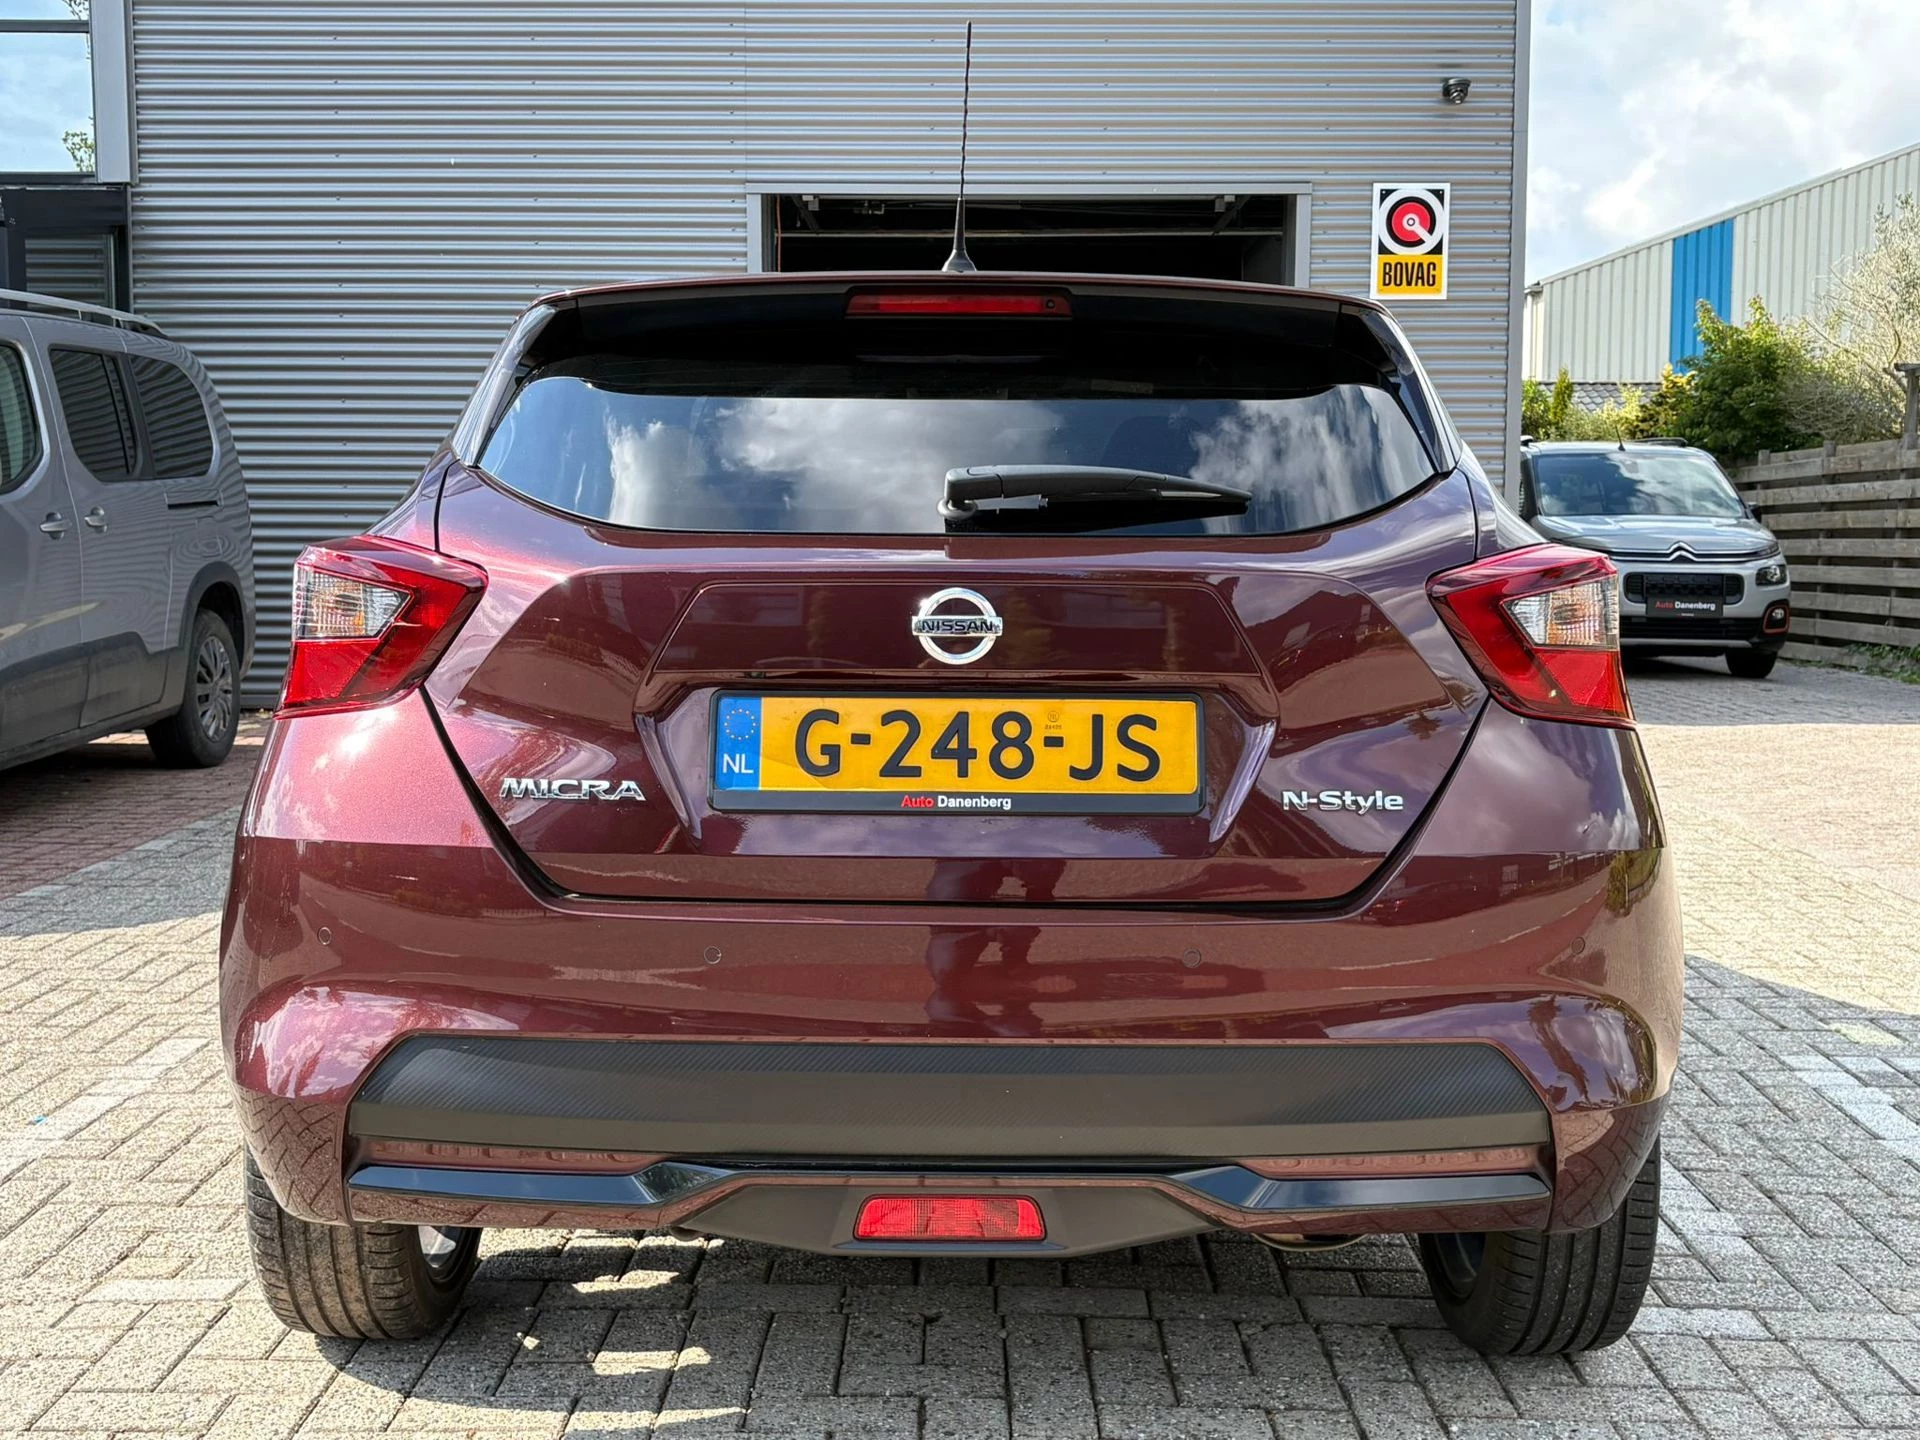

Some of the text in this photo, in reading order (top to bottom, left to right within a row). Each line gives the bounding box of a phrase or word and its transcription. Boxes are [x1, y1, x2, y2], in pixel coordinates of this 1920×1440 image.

[1382, 261, 1437, 288] BOVAG
[1655, 601, 1716, 611] Auto Danenberg
[921, 620, 993, 632] NISSAN
[794, 708, 1161, 782] G-248-JS
[722, 753, 754, 774] NL
[499, 777, 647, 801] MICRA
[901, 795, 1011, 811] Auto Danenberg
[1282, 790, 1404, 815] N-Style
